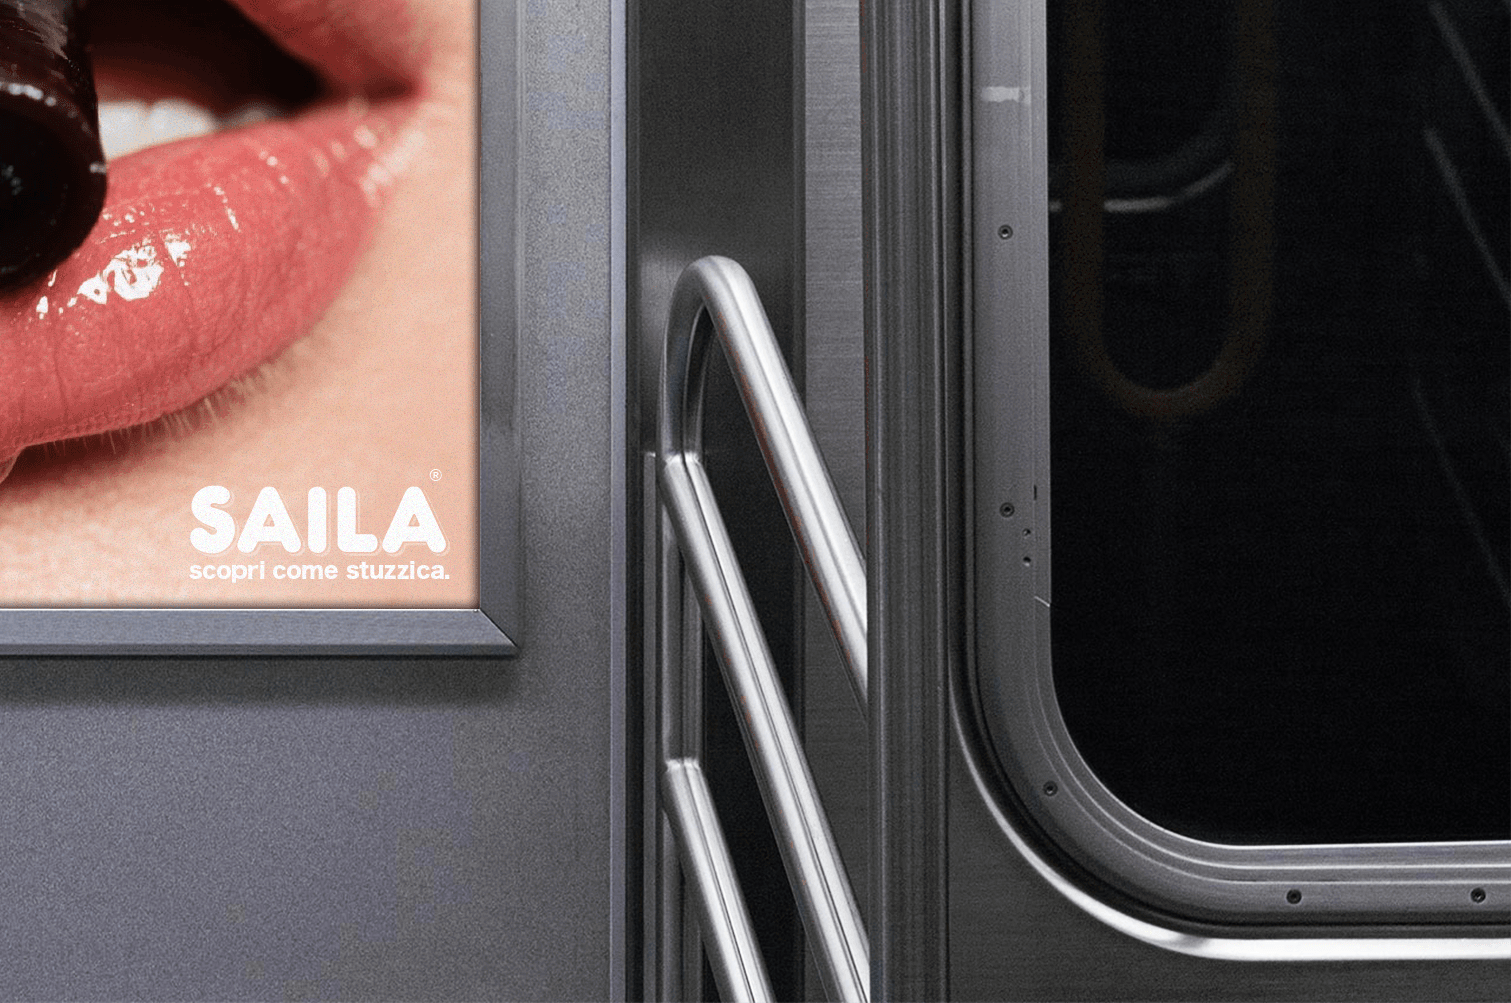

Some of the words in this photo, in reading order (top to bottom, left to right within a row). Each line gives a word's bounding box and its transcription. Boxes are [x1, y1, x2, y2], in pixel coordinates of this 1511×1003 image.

[189, 485, 450, 557] SAILA
[189, 561, 265, 583] scopri
[272, 565, 338, 580] come
[346, 561, 450, 580] stuzzica.
